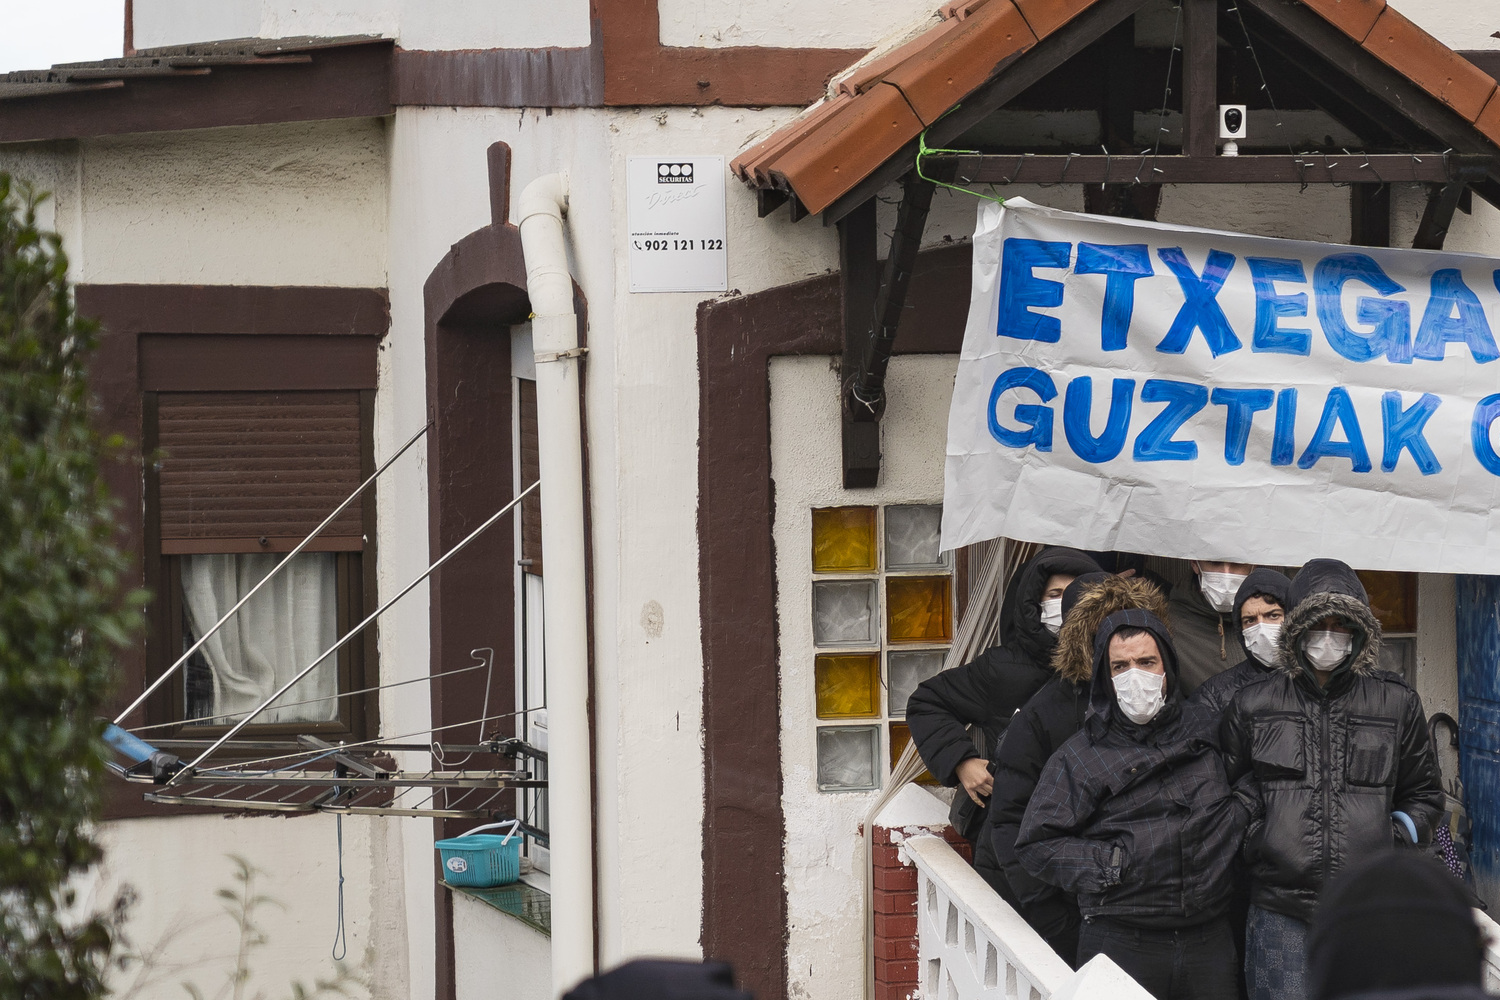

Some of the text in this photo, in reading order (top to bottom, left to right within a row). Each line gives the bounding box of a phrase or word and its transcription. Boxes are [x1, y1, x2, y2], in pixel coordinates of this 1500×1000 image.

[644, 239, 723, 250] 902 121 122
[987, 366, 1443, 475] GUZTIAK
